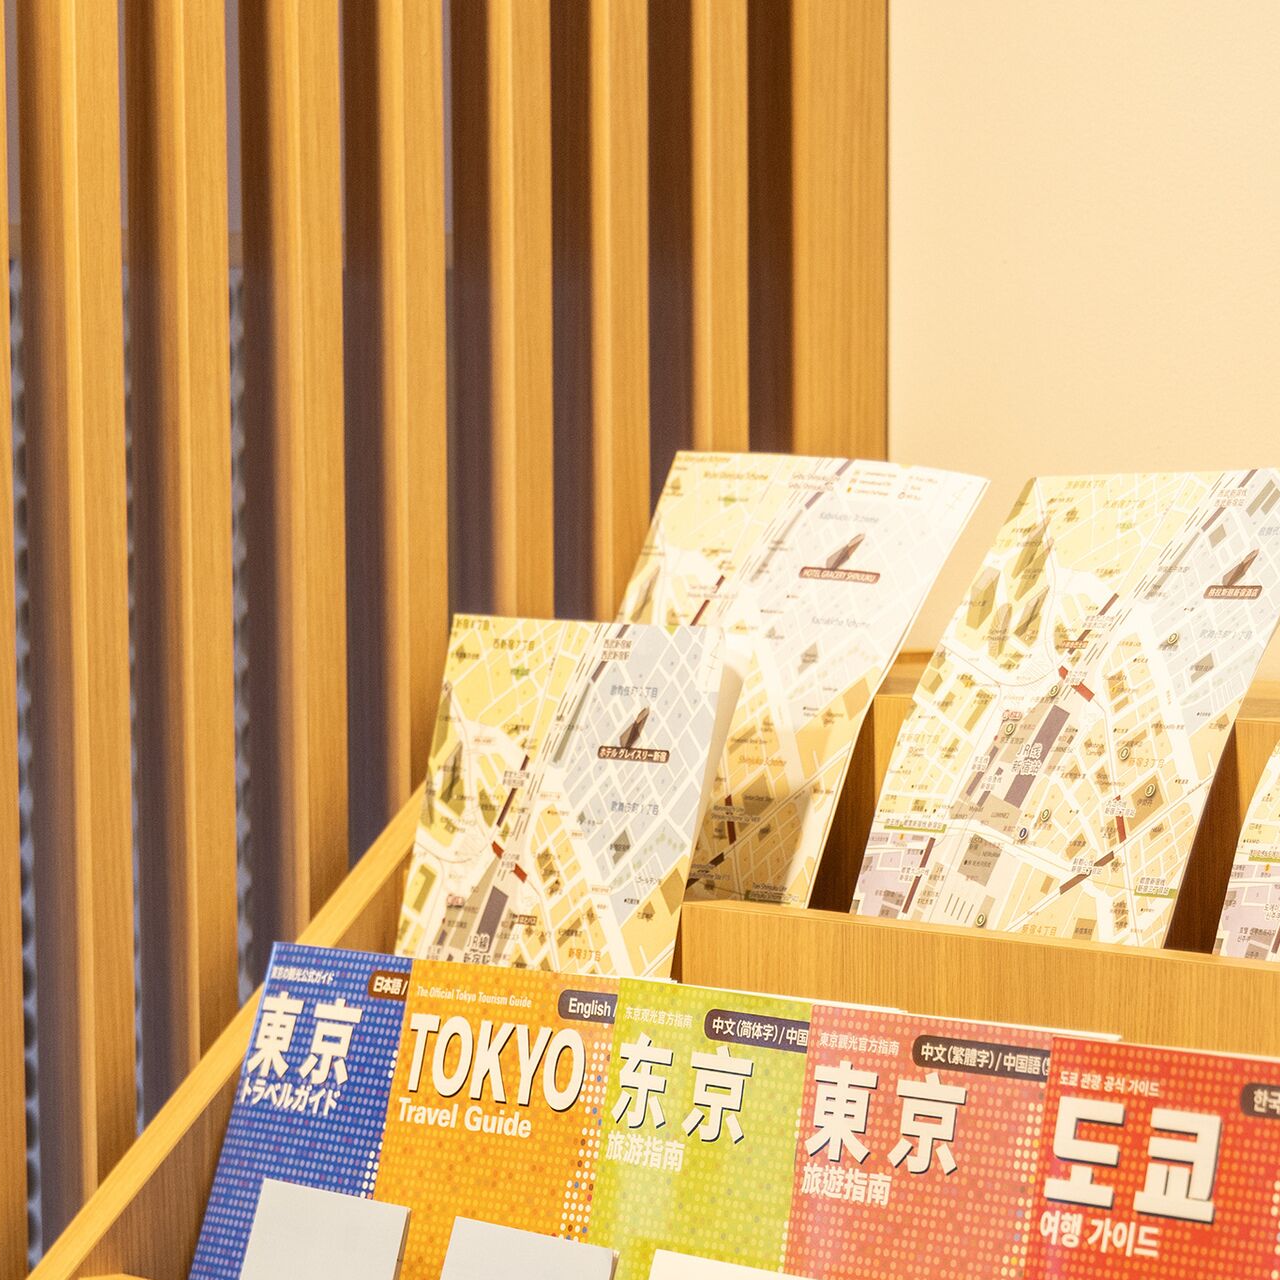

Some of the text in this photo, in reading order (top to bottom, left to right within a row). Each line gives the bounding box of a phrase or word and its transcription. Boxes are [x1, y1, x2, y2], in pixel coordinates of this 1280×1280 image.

[373, 976, 402, 995] 日本語
[417, 985, 532, 1009] The Official Tokyo Tourism Guide
[568, 997, 612, 1019] English
[624, 1006, 693, 1029] 东京观光官方指南
[246, 991, 363, 1086] 東京
[407, 1012, 587, 1113] TOKYO
[1059, 1070, 1161, 1098] 도쿄 관광 공식 가이드
[240, 1077, 341, 1117] トラベルガイド
[610, 1031, 754, 1145] 东京
[398, 1097, 532, 1139] Travel Guide
[803, 1060, 968, 1176] 東京
[605, 1130, 686, 1173] 旅游指南
[1043, 1095, 1223, 1226] 도쿄
[800, 1162, 892, 1206] 旅遊指南
[1039, 1210, 1161, 1258] 여행 가이드
